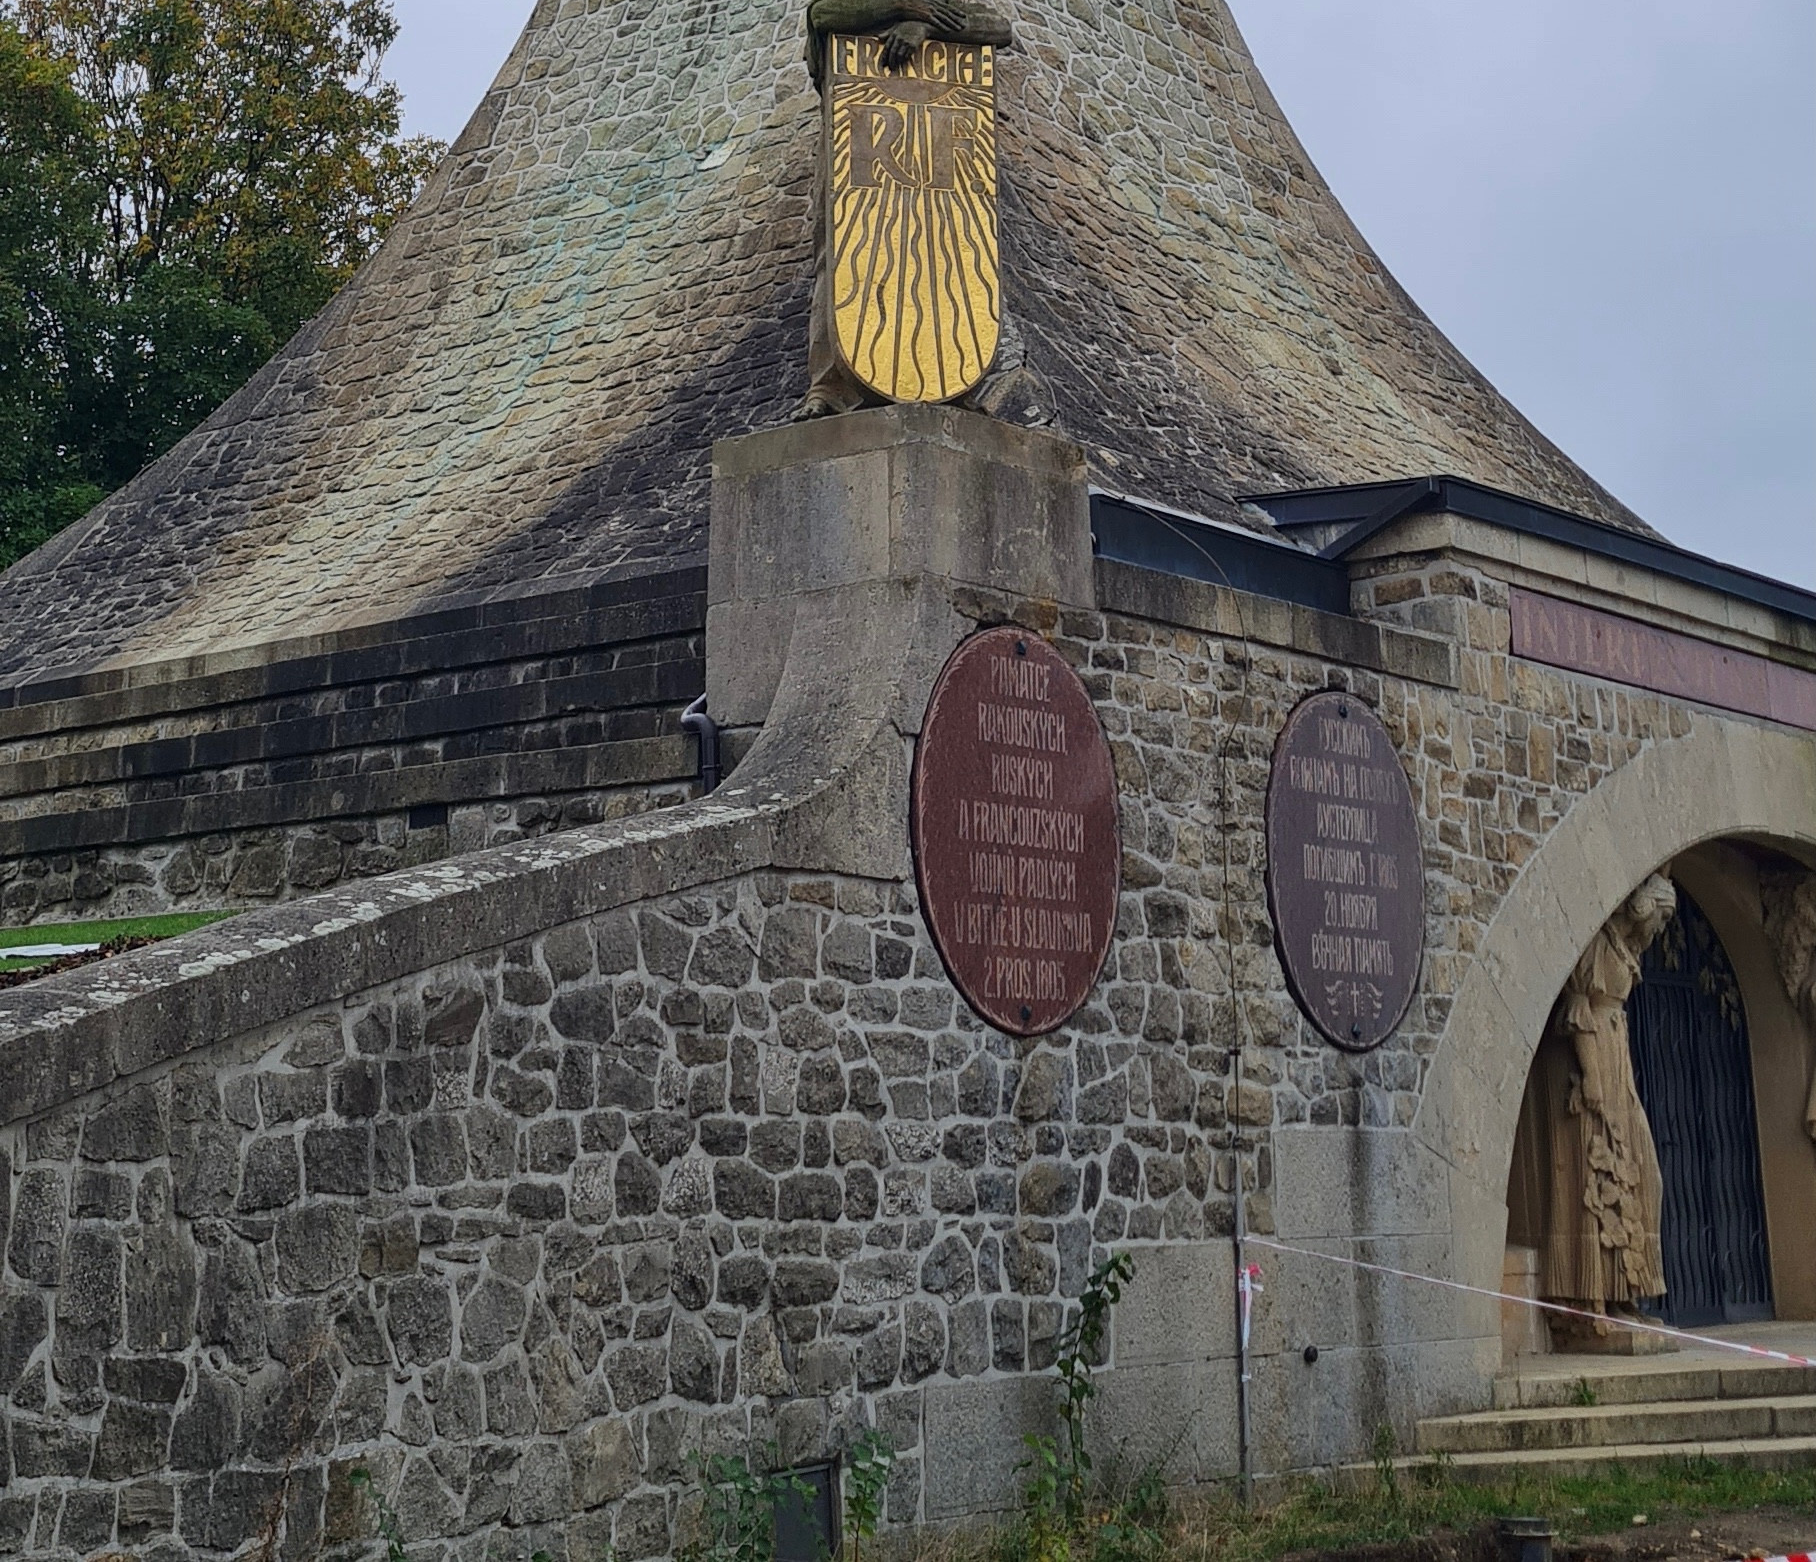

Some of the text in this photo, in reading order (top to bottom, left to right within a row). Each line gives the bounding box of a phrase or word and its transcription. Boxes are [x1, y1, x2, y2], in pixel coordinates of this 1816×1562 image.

[991, 752, 1054, 800] RUSKÝCH
[1343, 763, 1358, 799] НА
[959, 799, 1085, 854] A FRANCOUZSKÝCH
[1018, 854, 1077, 902] PADLÝCH
[954, 901, 965, 943] V
[968, 899, 1009, 947] BITVĚ
[1011, 906, 1021, 948] U
